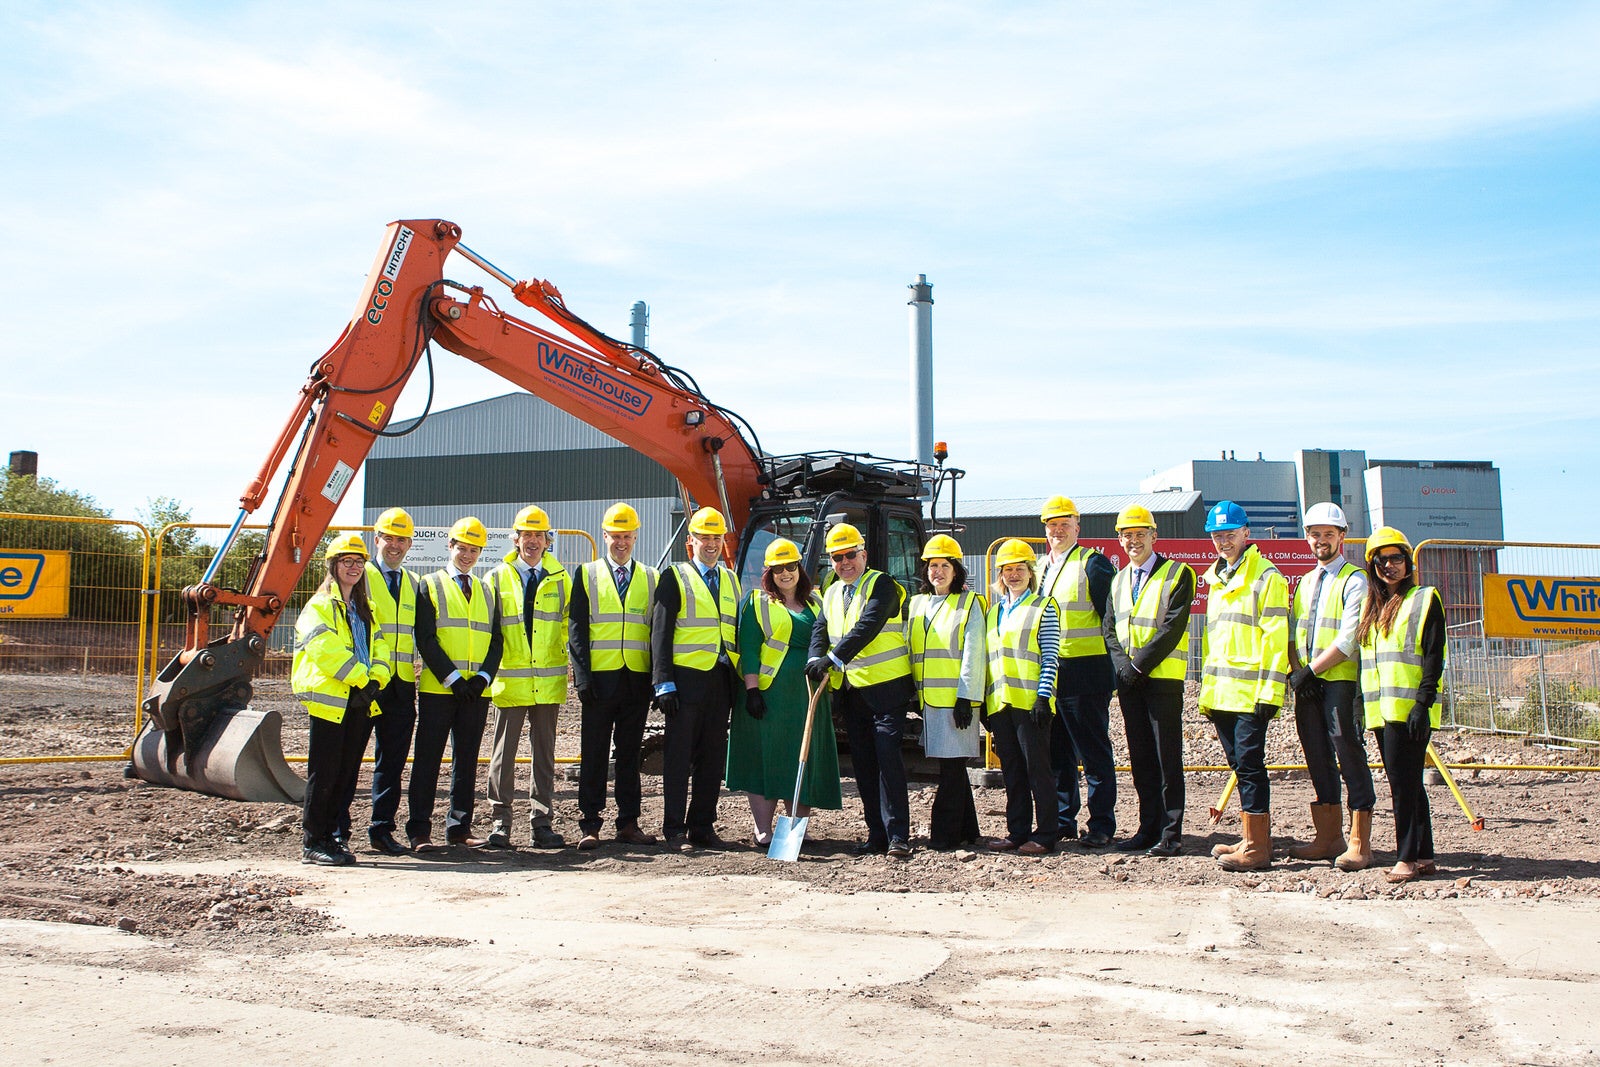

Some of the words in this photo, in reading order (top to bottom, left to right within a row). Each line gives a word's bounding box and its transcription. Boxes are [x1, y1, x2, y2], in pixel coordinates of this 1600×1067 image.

[387, 229, 413, 276] HITACHI
[367, 279, 393, 325] eco
[538, 342, 642, 407] Whitehouse
[487, 531, 510, 540] gineer
[1507, 579, 1600, 612] Whit
